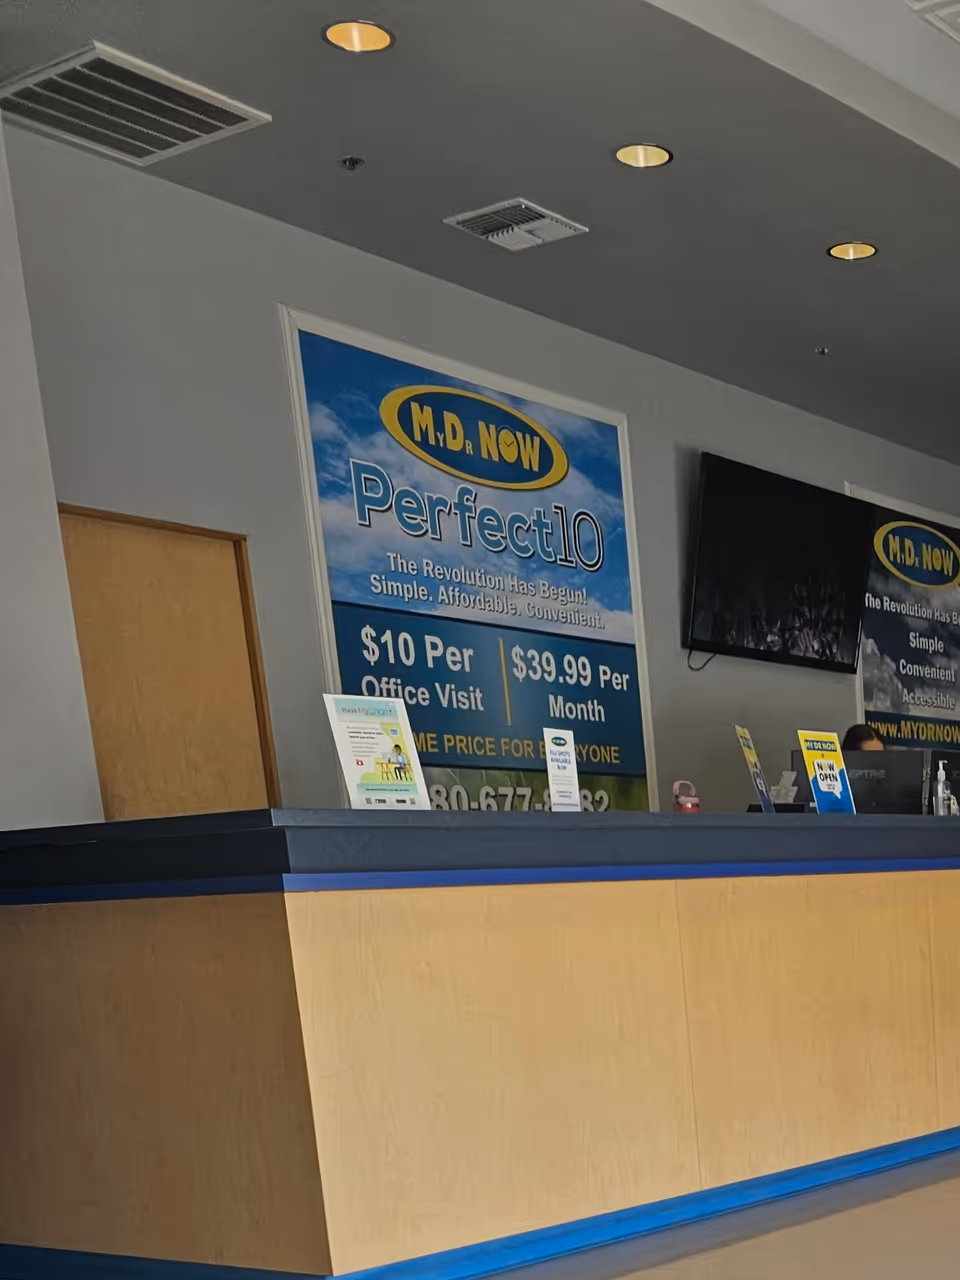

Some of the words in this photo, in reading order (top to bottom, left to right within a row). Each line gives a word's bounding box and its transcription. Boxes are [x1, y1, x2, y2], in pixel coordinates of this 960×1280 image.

[478, 420, 542, 473] NOW
[922, 542, 954, 577] NOW
[386, 552, 418, 576] The
[423, 558, 505, 593] Revolution
[508, 573, 537, 597] Has
[540, 579, 588, 607] Begun!
[369, 573, 433, 603] Simple.
[437, 584, 521, 617] Affordable.
[525, 601, 606, 629] Convenient.
[883, 596, 932, 620] Revolution
[934, 607, 951, 624] Has
[360, 624, 416, 667] $10
[424, 634, 474, 673] Per
[909, 631, 944, 655] Simple
[511, 644, 592, 687] $39.99
[599, 664, 630, 692] Per
[899, 658, 956, 683] Convenient
[361, 675, 430, 706] Office
[434, 682, 485, 711] Visit
[548, 694, 605, 723] Month
[902, 687, 956, 711] Accessible
[414, 732, 439, 753] ME
[443, 734, 498, 757] PRICE
[501, 737, 536, 758] FOR
[819, 772, 838, 783] OPEN
